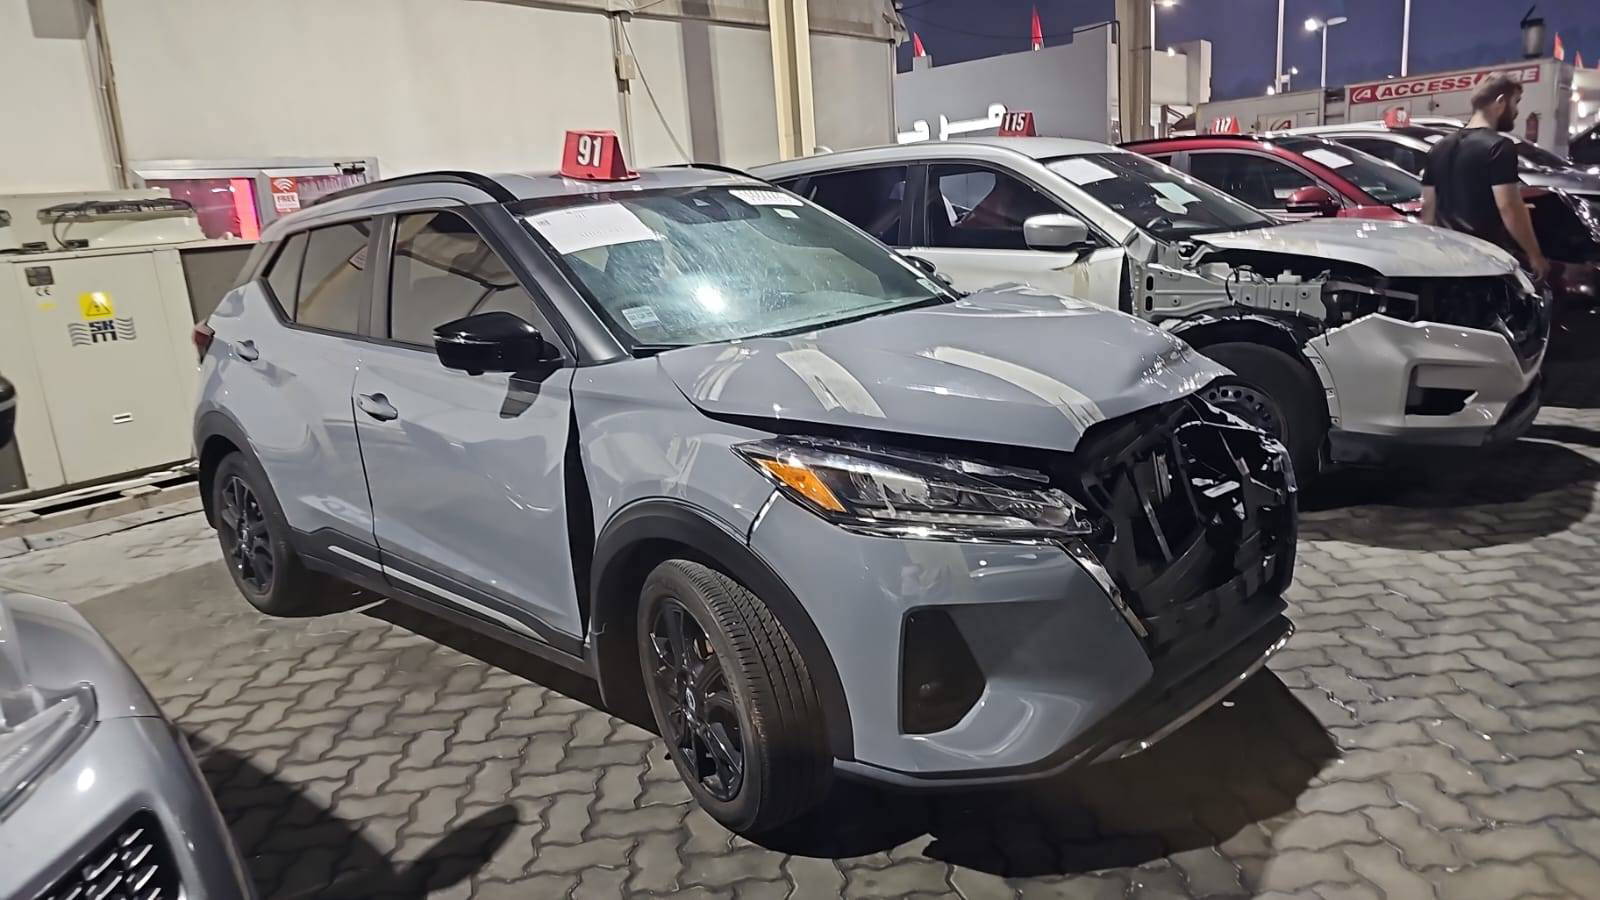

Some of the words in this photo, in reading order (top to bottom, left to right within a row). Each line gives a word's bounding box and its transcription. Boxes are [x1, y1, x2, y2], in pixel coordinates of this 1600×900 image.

[1380, 76, 1472, 96] ACCESS
[1004, 112, 1026, 132] 115
[577, 135, 603, 168] 91
